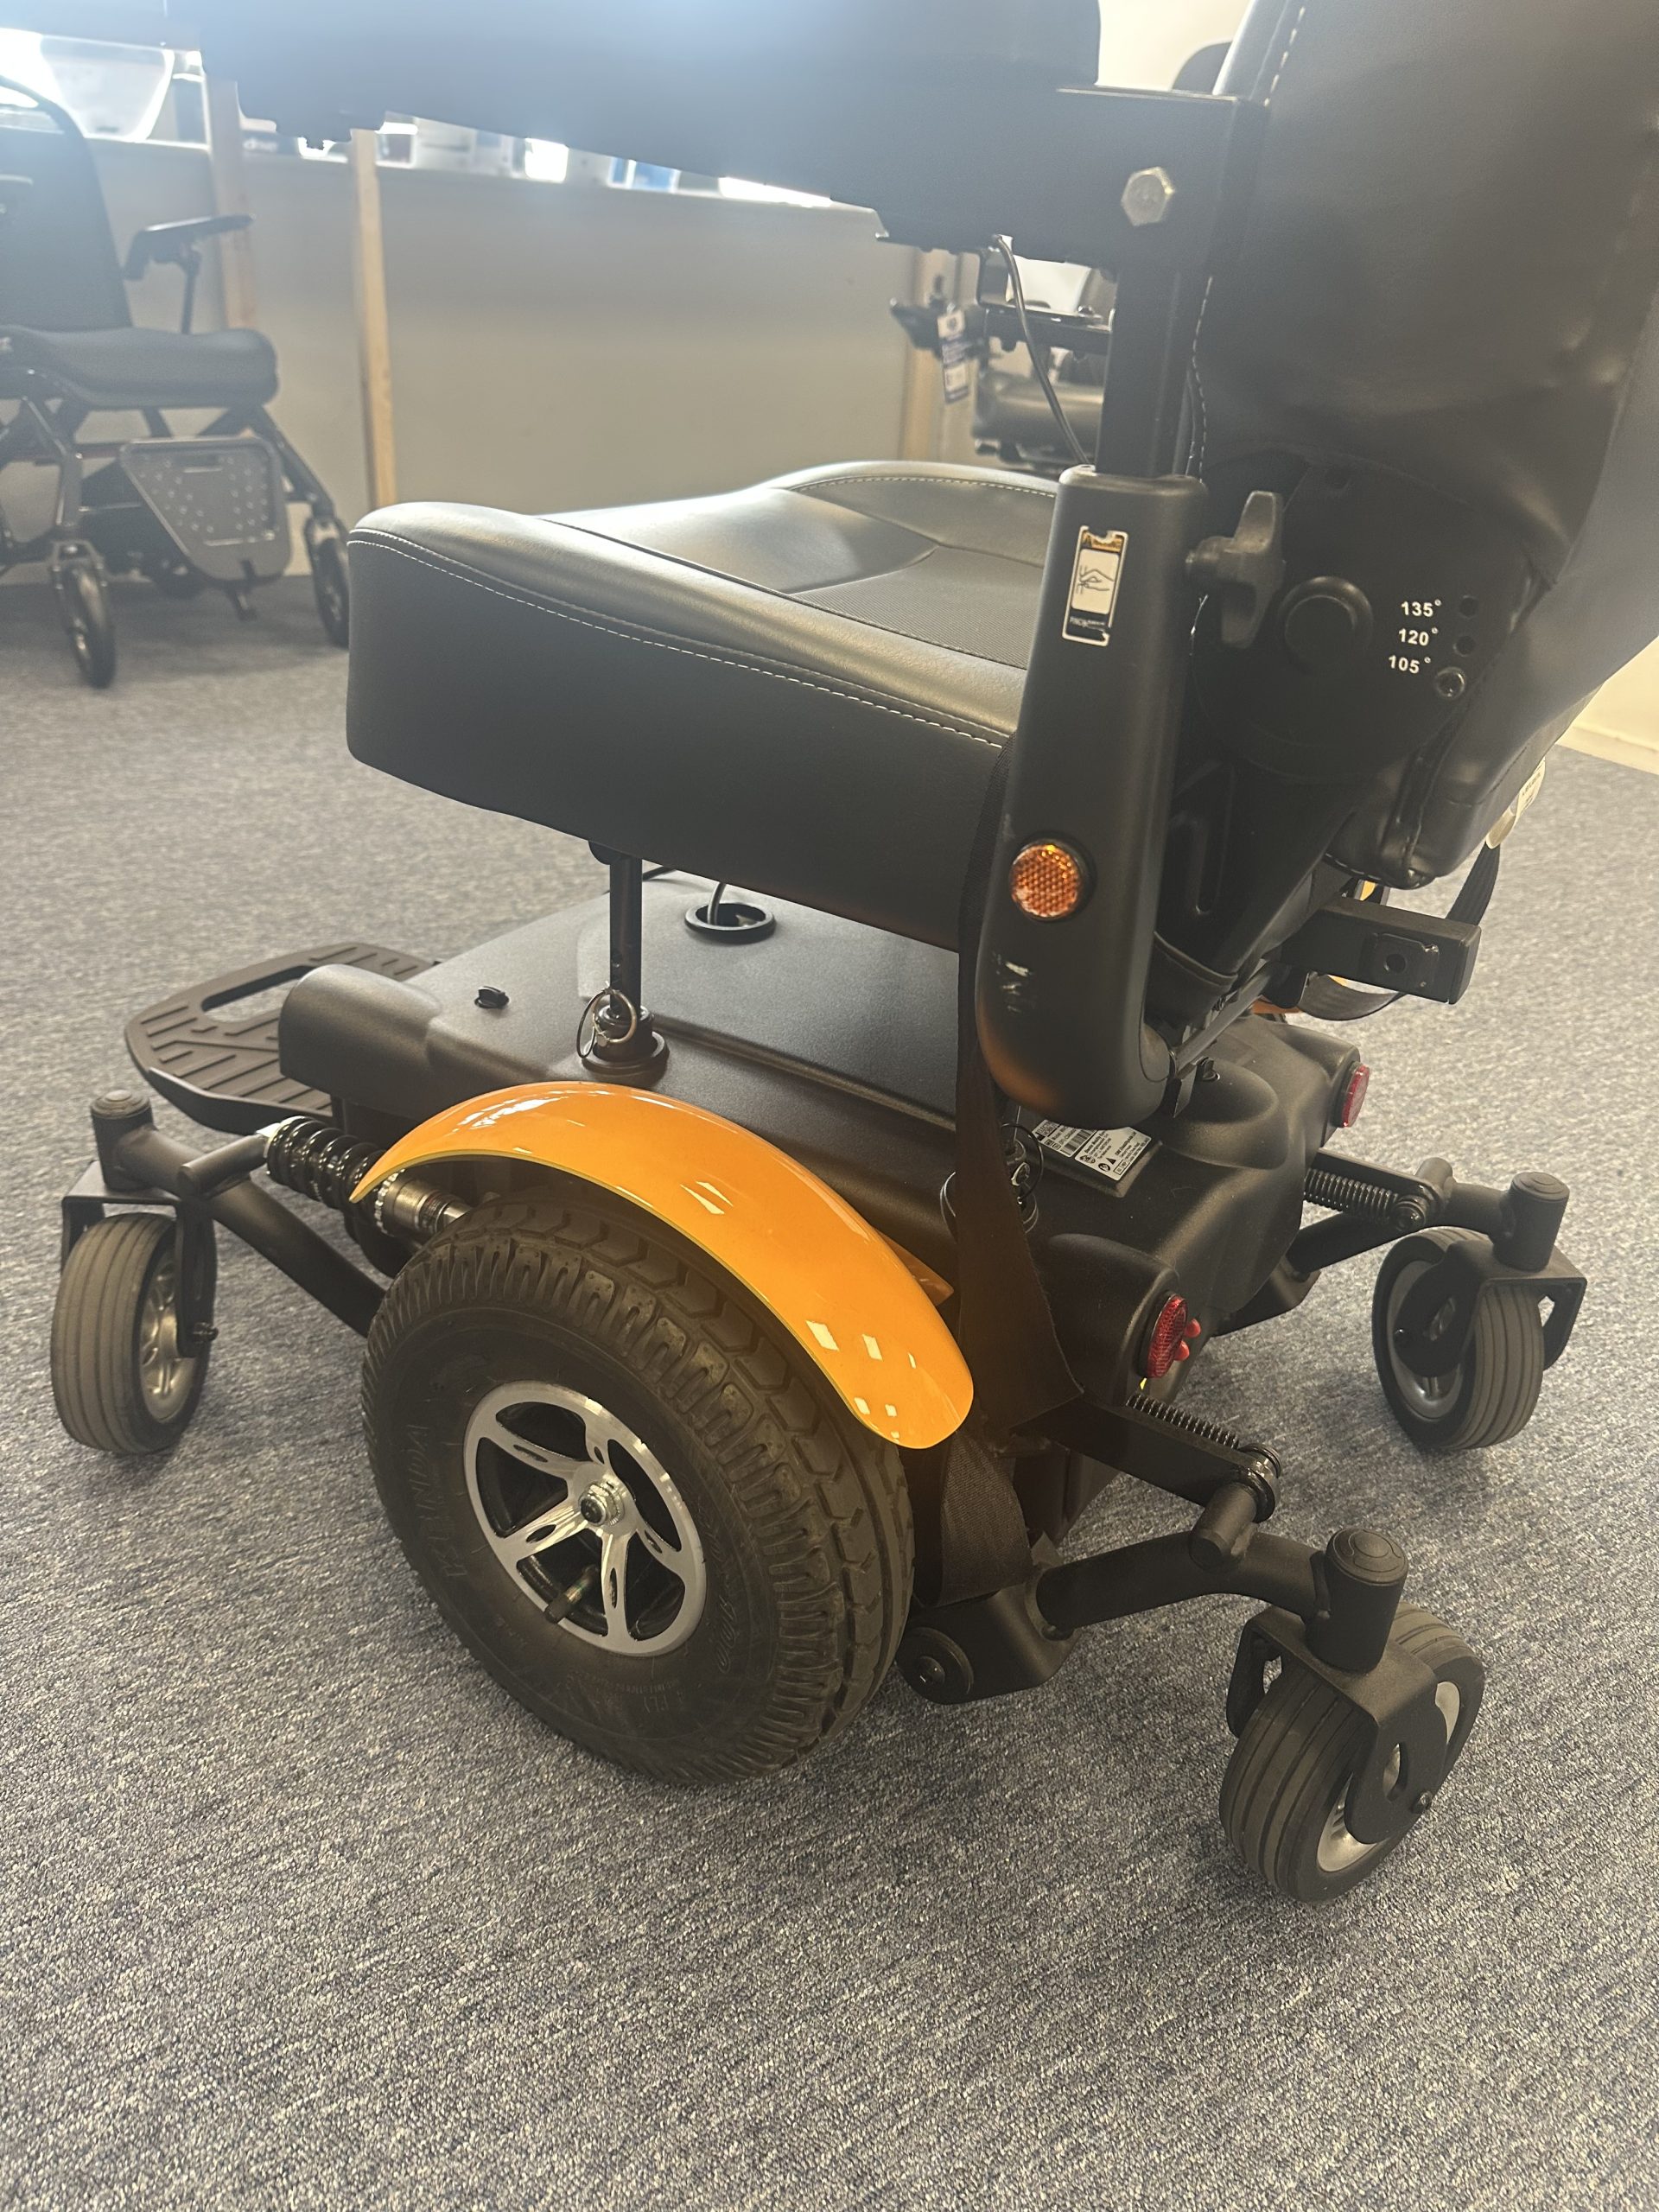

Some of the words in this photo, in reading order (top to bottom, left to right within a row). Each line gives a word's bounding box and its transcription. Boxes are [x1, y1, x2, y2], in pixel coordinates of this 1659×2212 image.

[1401, 599, 1441, 617] 135°
[1398, 626, 1438, 646] 120°
[1389, 654, 1431, 674] 105°
